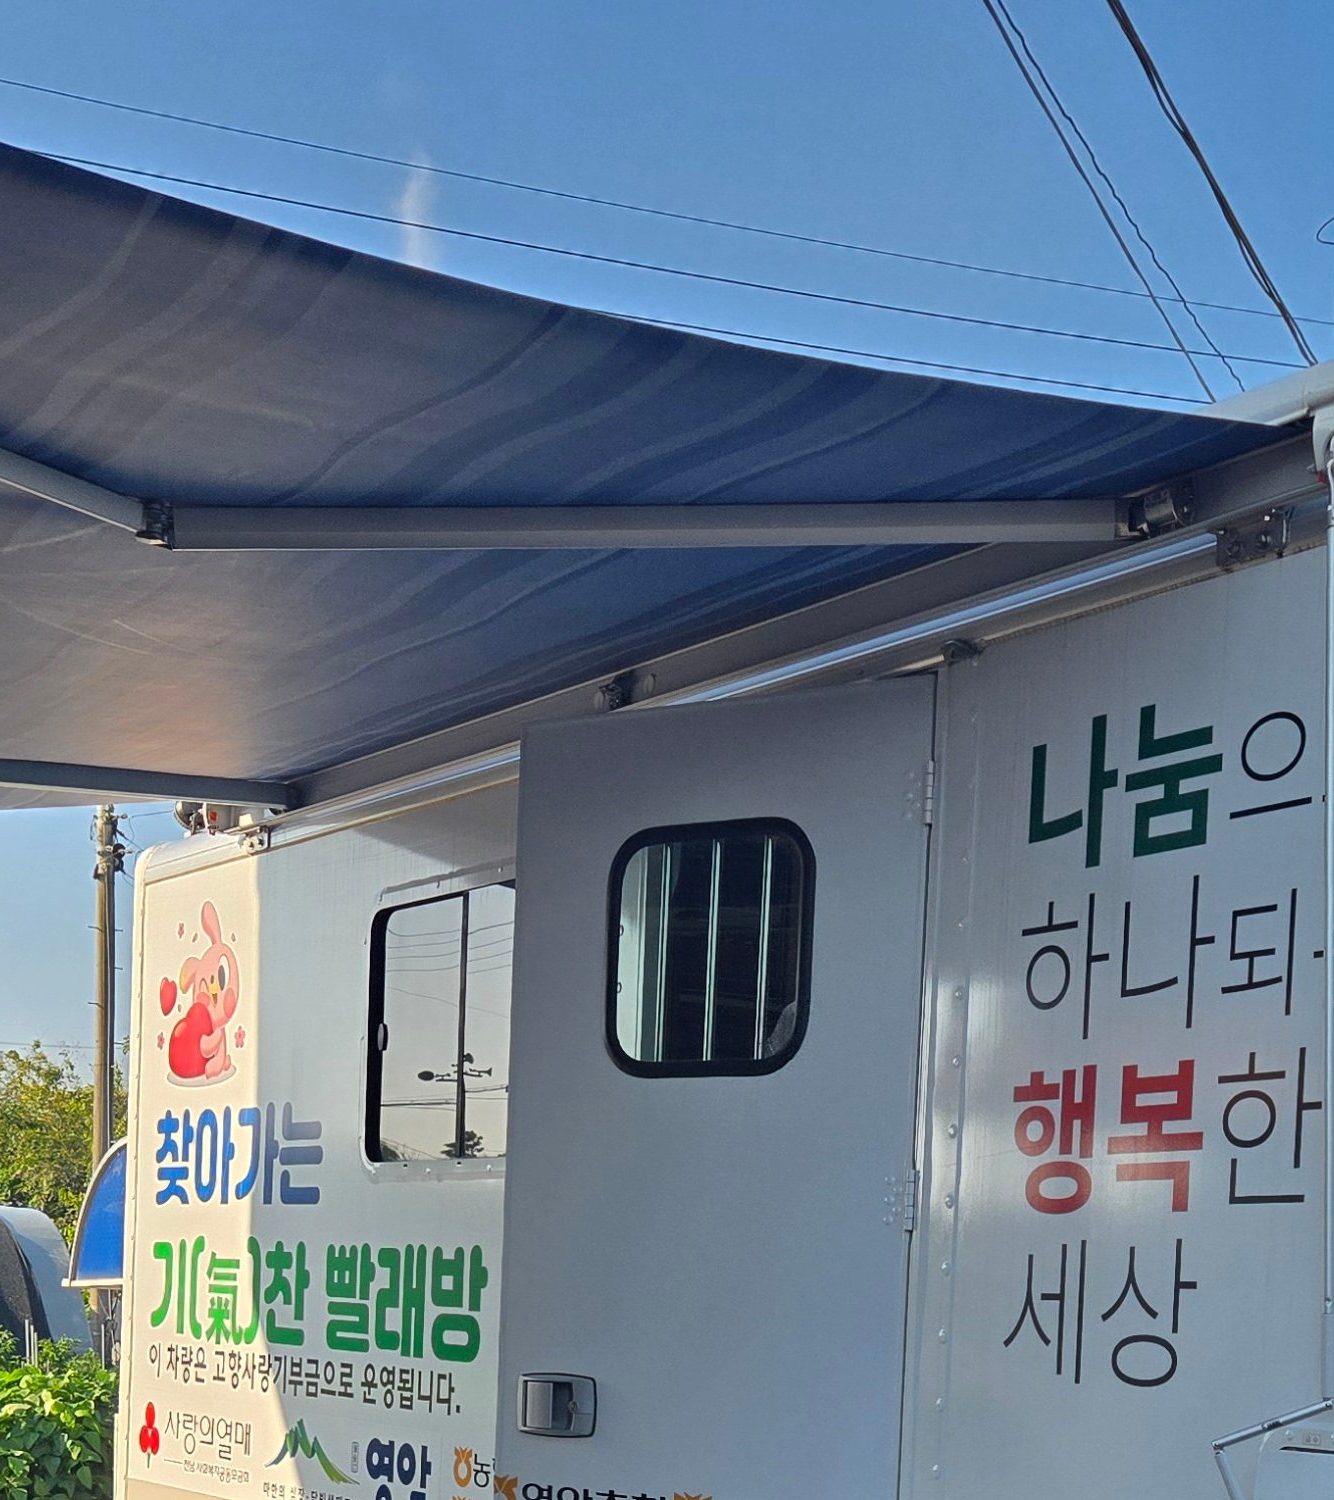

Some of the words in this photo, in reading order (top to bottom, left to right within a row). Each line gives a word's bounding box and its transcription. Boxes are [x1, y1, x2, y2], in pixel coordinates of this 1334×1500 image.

[155, 1101, 323, 1205] 찾아가는
[1013, 1047, 1322, 1215] 행복한
[150, 1235, 310, 1346] 기(氣)찬
[326, 1242, 489, 1363] 빨래방
[1003, 1238, 1197, 1387] 세상
[149, 1343, 161, 1377] 이
[167, 1346, 207, 1384] 차량은
[212, 1350, 354, 1399] 고향사랑기부금으로
[361, 1362, 461, 1416] 운영됩니다.
[164, 1411, 252, 1461] 사랑의열매
[473, 1453, 496, 1488] 농
